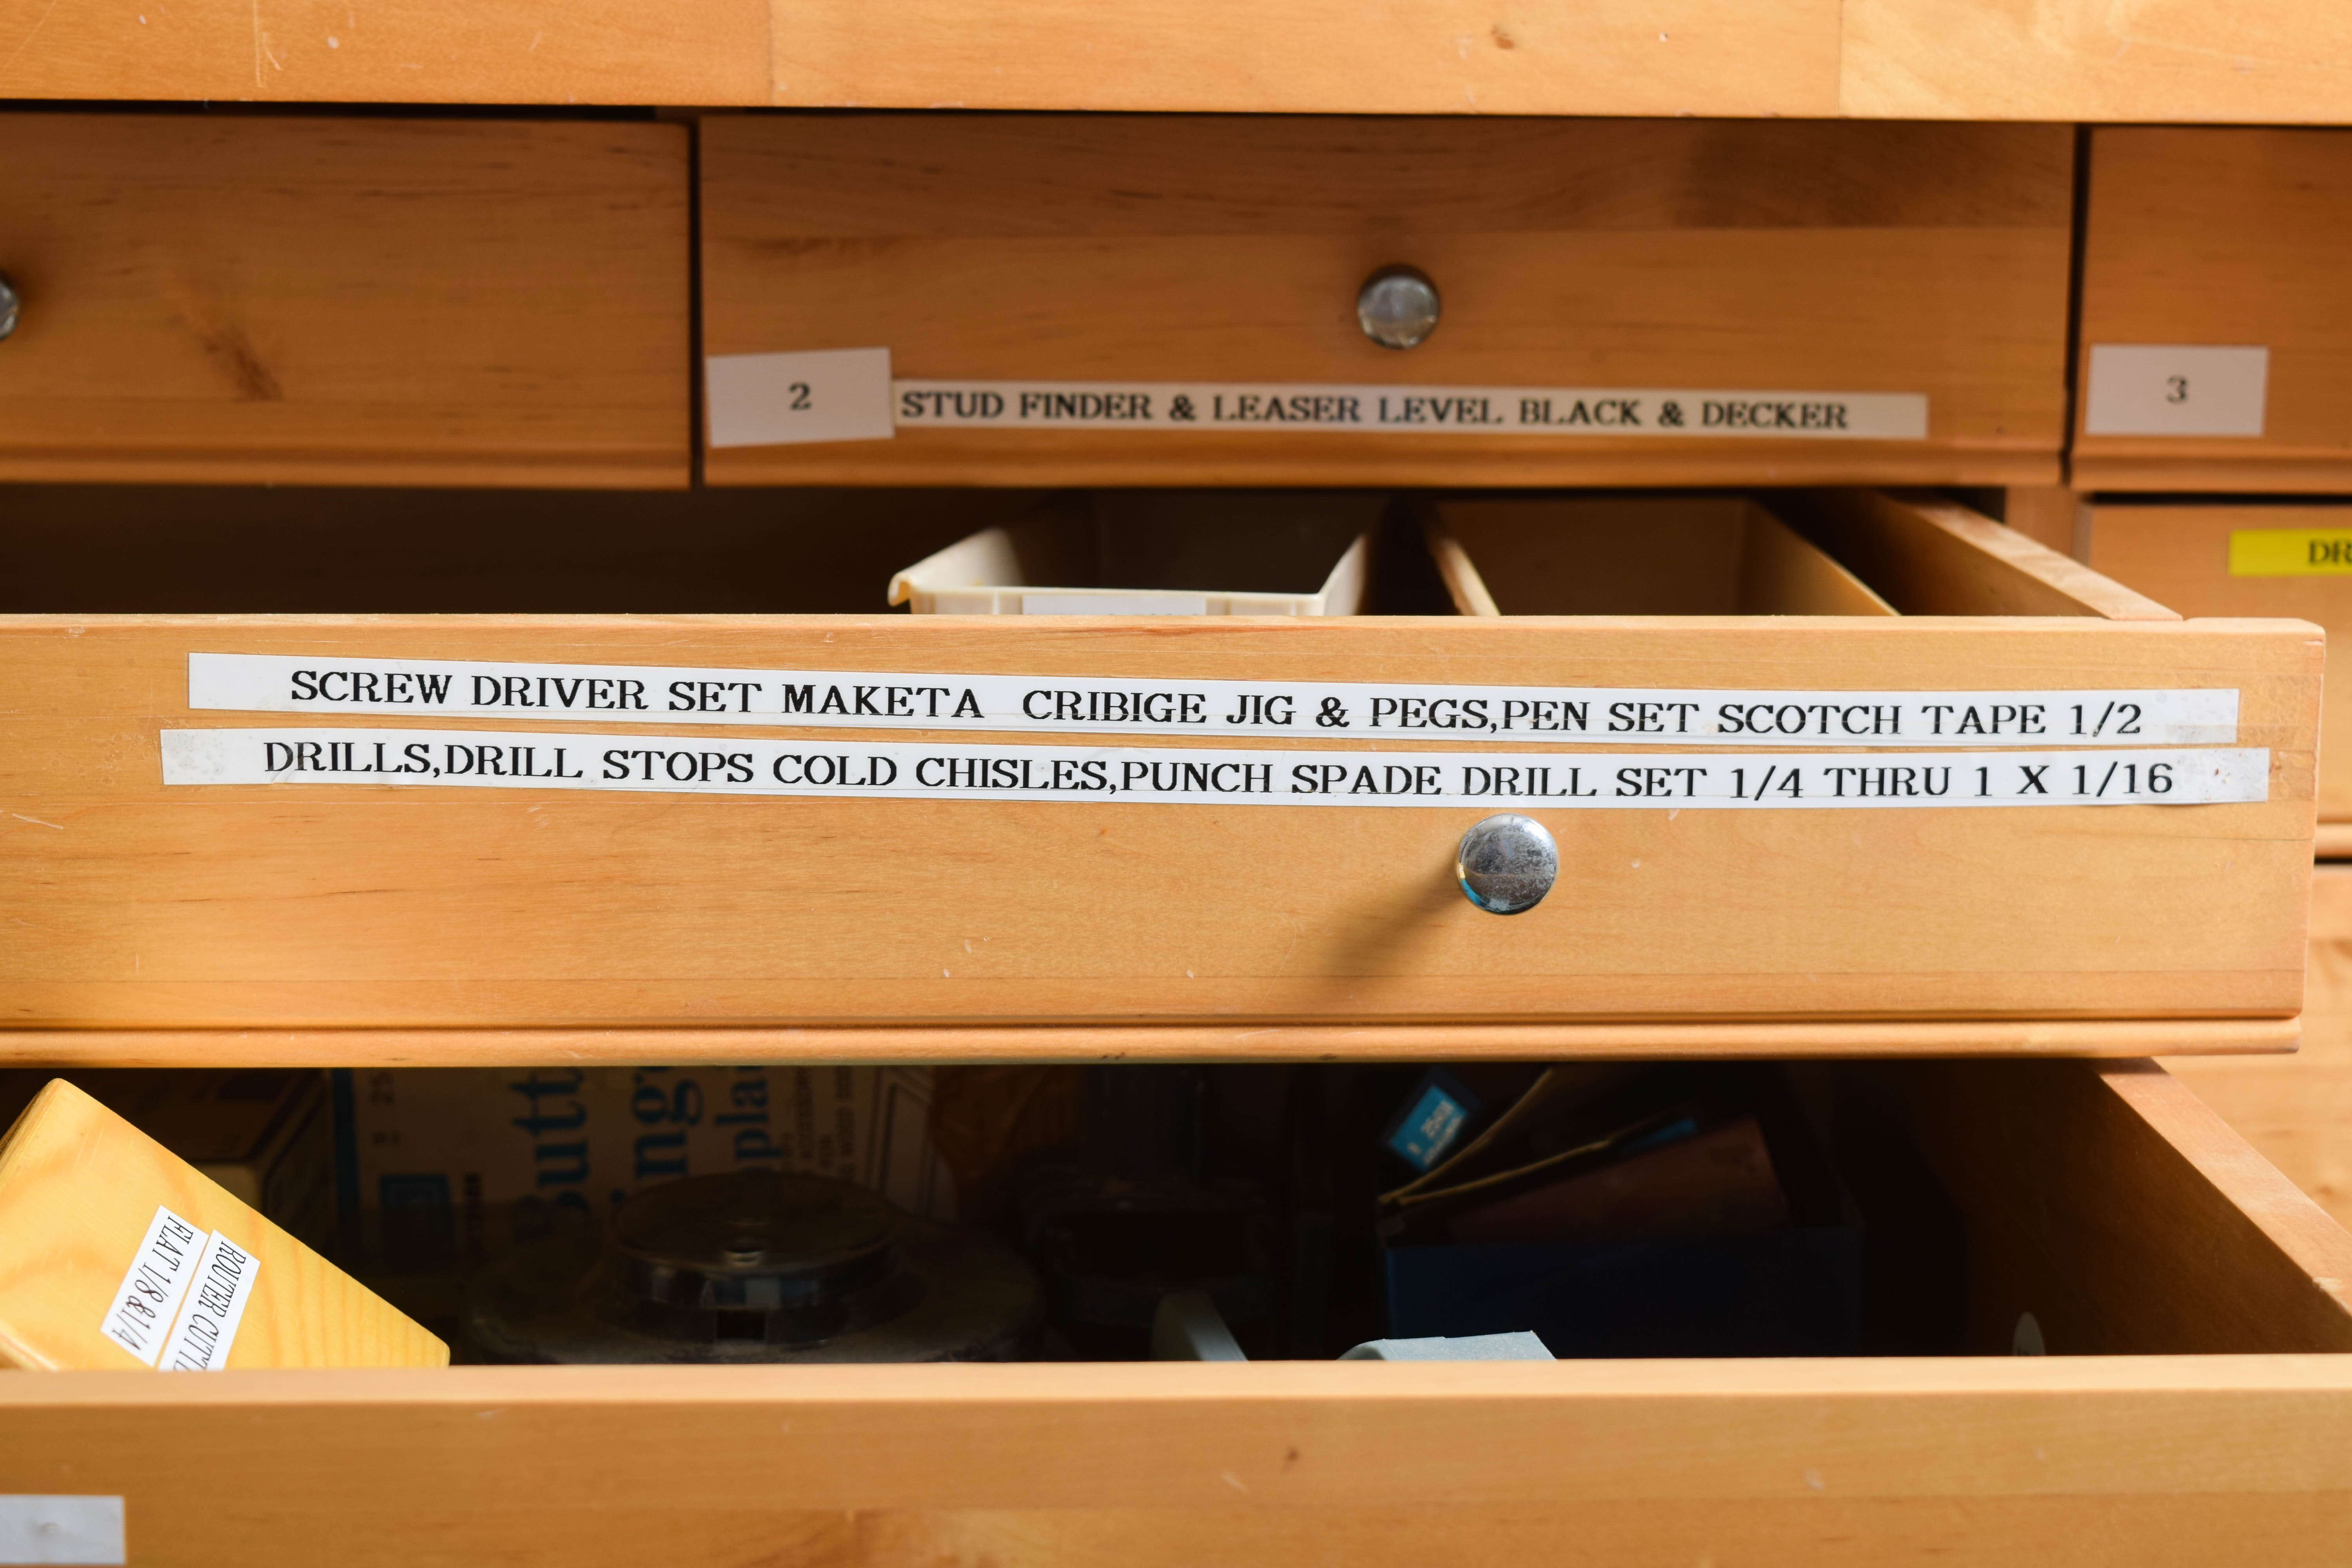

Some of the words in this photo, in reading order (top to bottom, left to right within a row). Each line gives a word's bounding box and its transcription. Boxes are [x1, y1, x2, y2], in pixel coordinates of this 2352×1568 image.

[788, 382, 813, 411] 2
[901, 390, 1005, 419] STUD
[1019, 392, 1152, 420] FINDER
[1168, 394, 1196, 422] &
[1213, 394, 1360, 423] LEASER
[1379, 397, 1503, 424] LEVEL
[1519, 399, 1640, 426] BLACK
[1657, 401, 1684, 427] &
[1702, 401, 1847, 429] DECKER
[2166, 376, 2188, 404] 3
[291, 670, 454, 704] SCREW
[470, 675, 650, 710] DRIVER
[668, 681, 763, 713] SET
[781, 683, 985, 719] MAKETA
[1022, 690, 1207, 723] CRIBIGE
[1225, 694, 1297, 724] JIG
[1315, 696, 1350, 725] &
[1369, 697, 1591, 729] PEGS,PEN
[1608, 702, 1700, 731] SET
[1717, 704, 1902, 735] SCOTCH
[1921, 704, 2046, 735] TAPE
[2070, 701, 2142, 737] 1/2
[263, 741, 584, 779] DRILLS,DRILL
[603, 749, 754, 783] STOPS
[773, 754, 898, 786] COLD
[915, 757, 1274, 794] CHISLES,PUNCH
[1291, 764, 1442, 796] SPADE
[1461, 766, 1598, 796] DRILL
[1615, 768, 1708, 797] SET
[1730, 765, 1804, 799] 1/4
[1823, 766, 1951, 797] THRU
[1975, 766, 1991, 797] 1
[2017, 765, 2049, 795] X
[2072, 762, 2174, 797] 1/16
[152, 1216, 194, 1272] FLAT
[135, 1262, 172, 1302] 1/8
[198, 1241, 247, 1318] ROUTER
